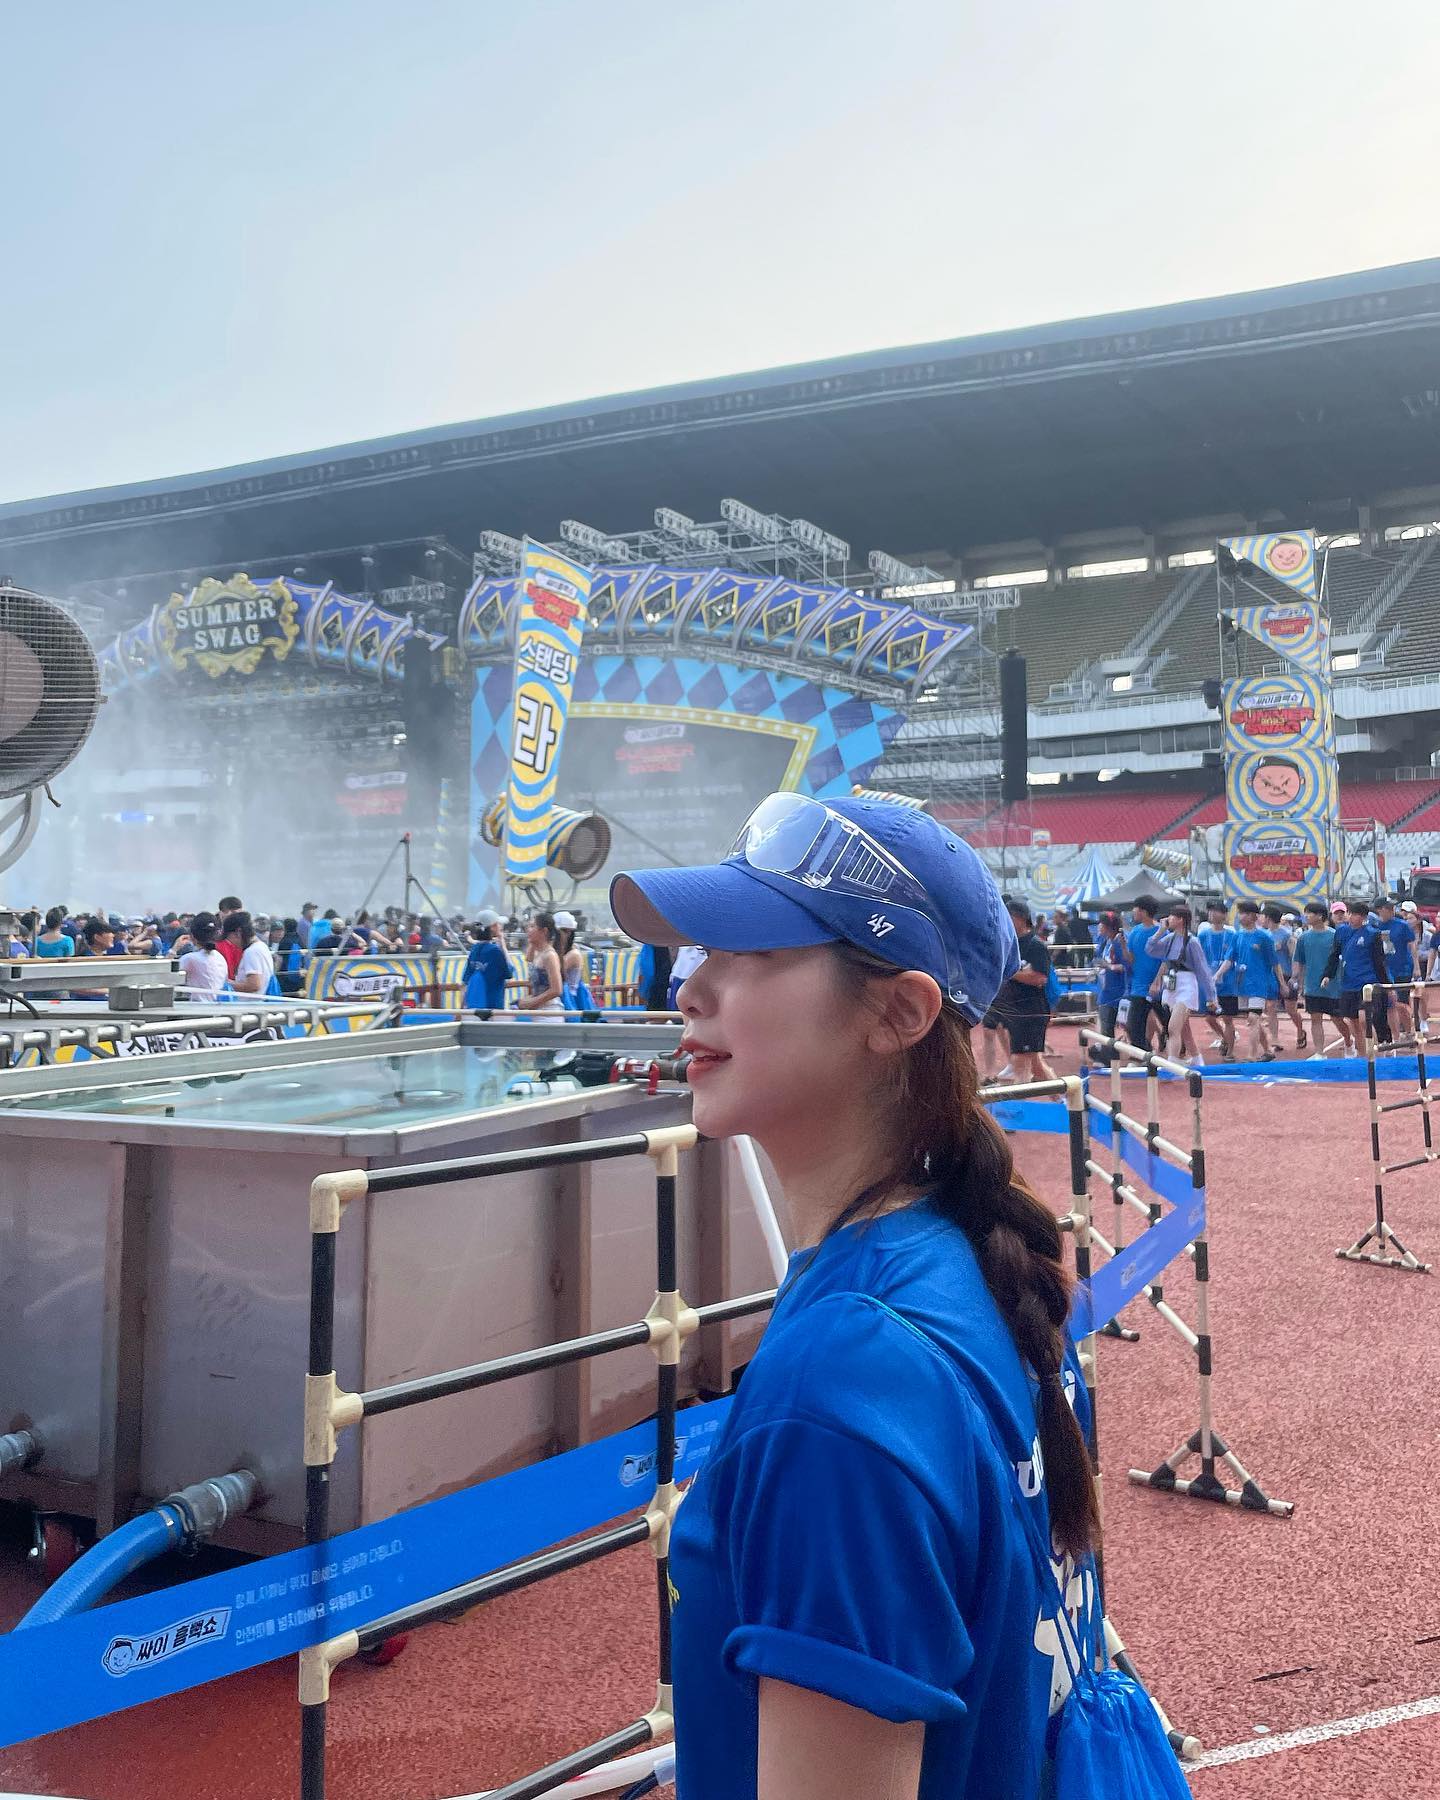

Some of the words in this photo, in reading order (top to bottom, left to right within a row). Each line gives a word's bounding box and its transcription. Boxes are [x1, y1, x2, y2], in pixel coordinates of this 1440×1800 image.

[176, 598, 276, 630] SUMMER
[194, 623, 260, 650] SWAG
[518, 638, 571, 684] 스탠딩
[514, 694, 556, 773] 라
[136, 1633, 169, 1661] 싸이
[172, 1616, 218, 1648] 흠뻑쇼
